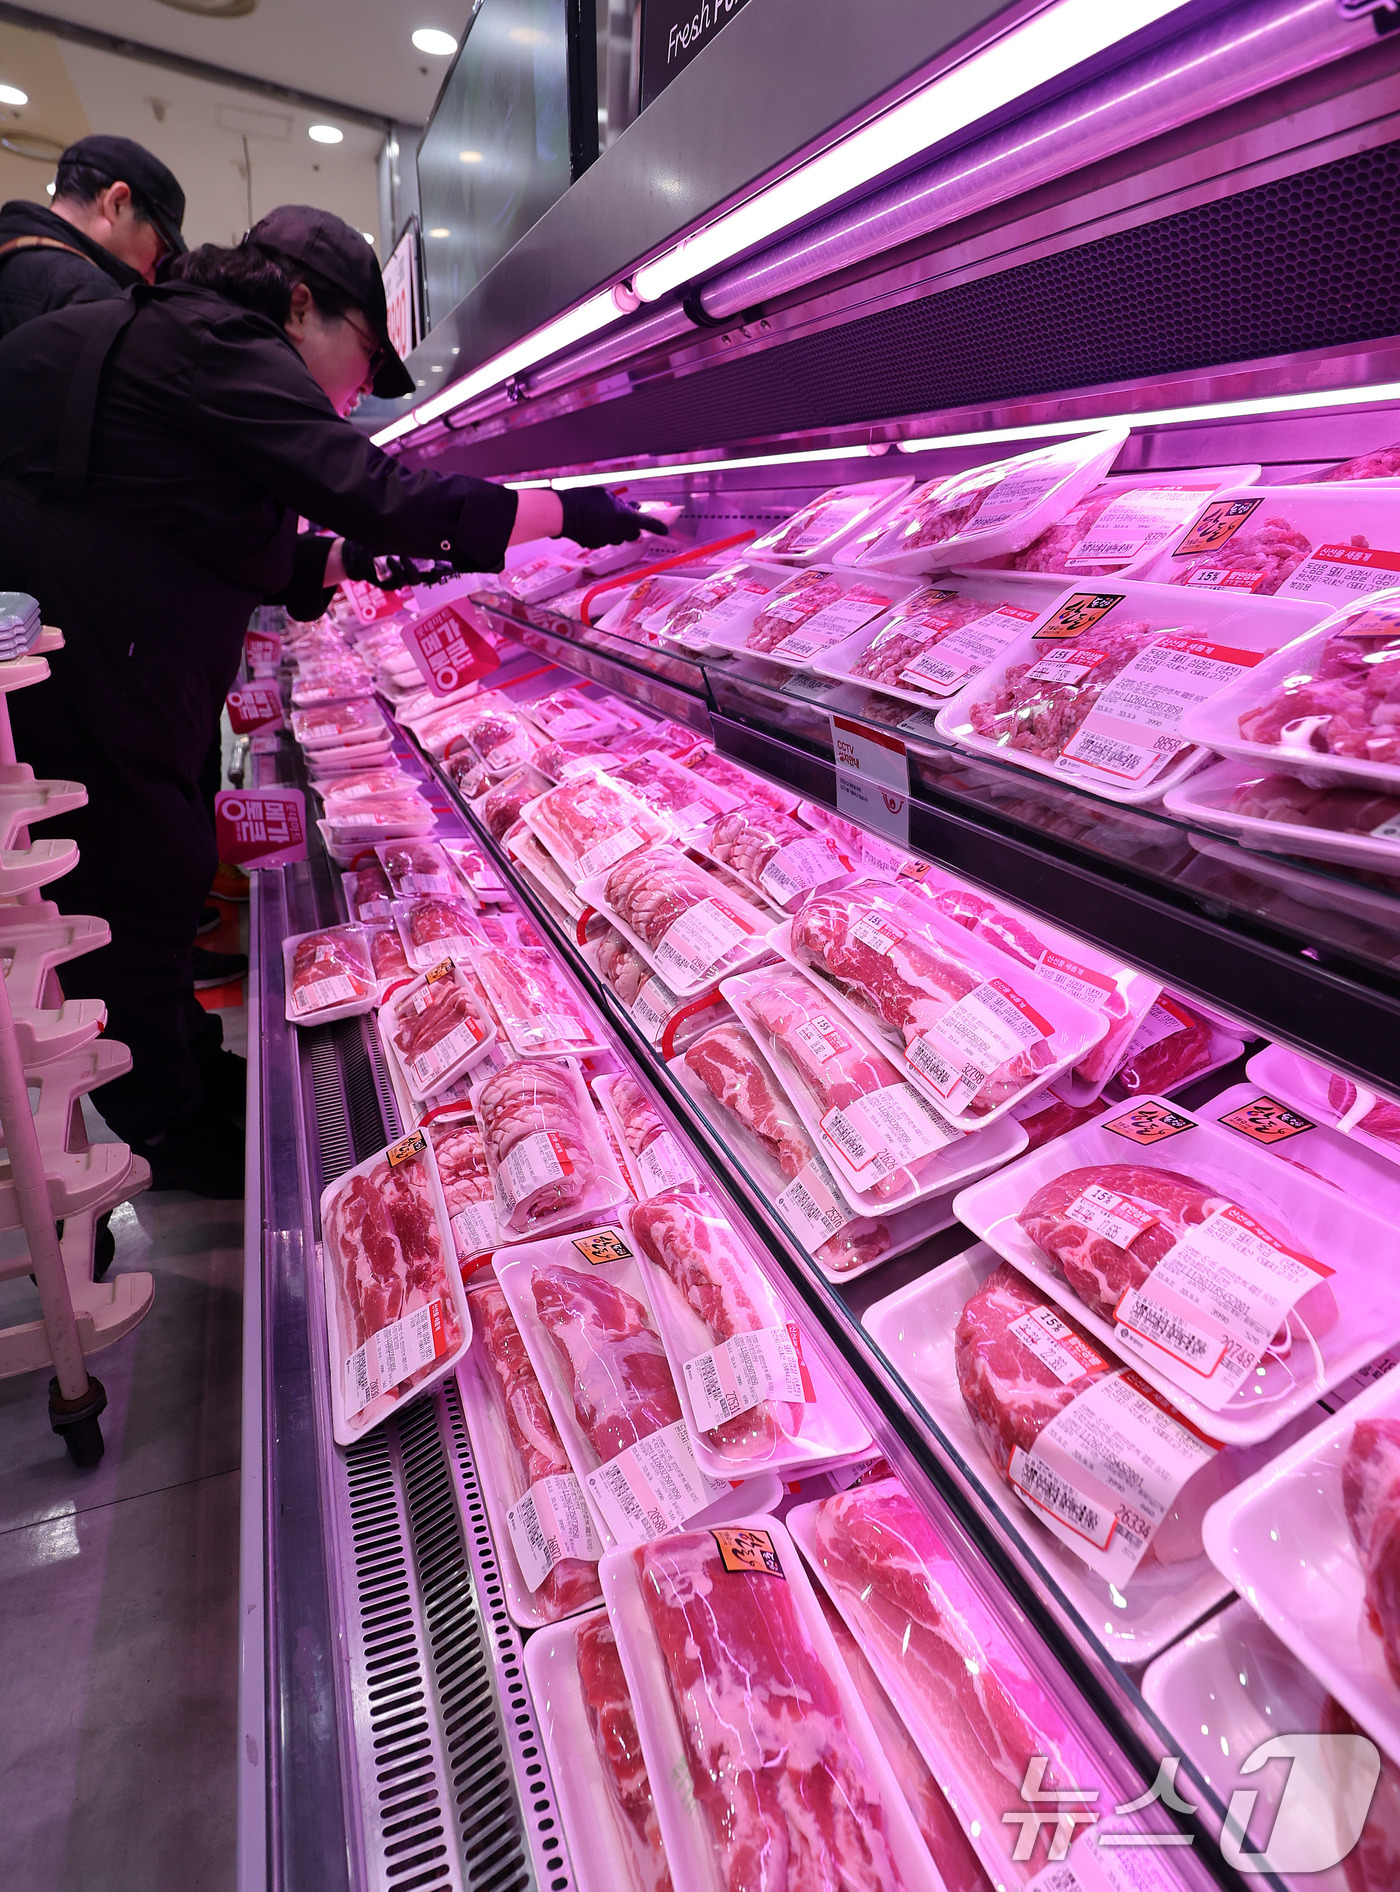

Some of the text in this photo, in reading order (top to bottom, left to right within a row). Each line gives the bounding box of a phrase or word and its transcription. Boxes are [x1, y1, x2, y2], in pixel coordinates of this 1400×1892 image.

[667, 0, 711, 64] Fresh
[1144, 532, 1167, 541] 8379
[1197, 571, 1222, 582] 15%
[1327, 565, 1346, 578] 돼지
[420, 618, 461, 657] 메가
[428, 636, 471, 690] 통큰
[1170, 652, 1188, 664] 돼지
[1146, 718, 1163, 727] 3990
[837, 740, 854, 754] CCTV
[1153, 736, 1182, 752] 8858
[222, 798, 263, 842] 통큰
[264, 800, 289, 842] 메가
[961, 1062, 985, 1085] 32798
[877, 1148, 898, 1170] 21626
[1091, 1189, 1114, 1205] 15%
[825, 1206, 844, 1227] 25376
[1039, 1312, 1067, 1333] 15%
[1210, 1308, 1230, 1325] 3990
[1220, 1335, 1256, 1368] 20748
[725, 1391, 740, 1415] 27531
[647, 1507, 668, 1533] 20588
[1114, 1502, 1151, 1539] 26334
[547, 1535, 562, 1563] 26972
